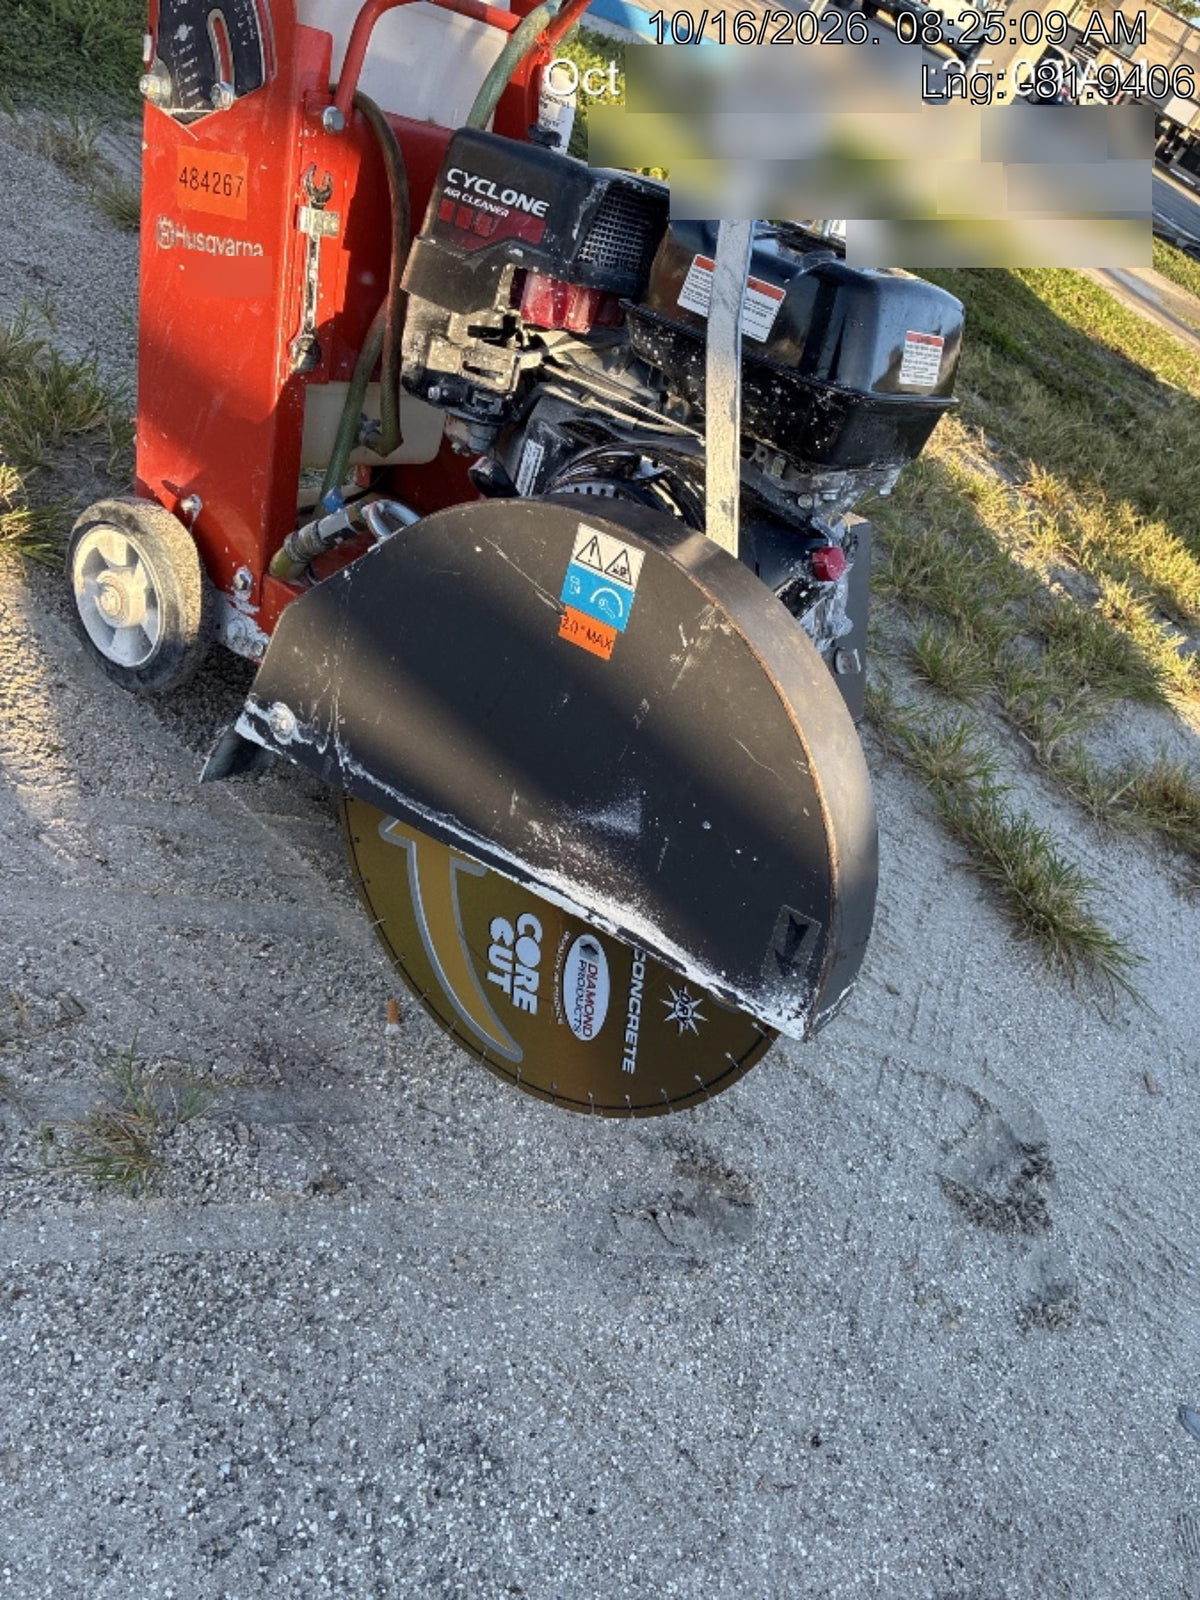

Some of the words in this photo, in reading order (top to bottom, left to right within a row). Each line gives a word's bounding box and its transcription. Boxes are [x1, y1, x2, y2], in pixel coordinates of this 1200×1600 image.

[178, 165, 245, 199] 484267
[443, 186, 462, 199] AIR
[461, 191, 510, 218] CLEANER
[446, 167, 550, 218] CYCLONE
[175, 224, 264, 257] Husqvarna
[486, 917, 515, 996] CUT
[511, 913, 543, 1016] CORE
[572, 959, 588, 1034] PRODUCTS
[582, 962, 599, 1038] DIAMOND
[622, 949, 648, 1075] CONCRETE
